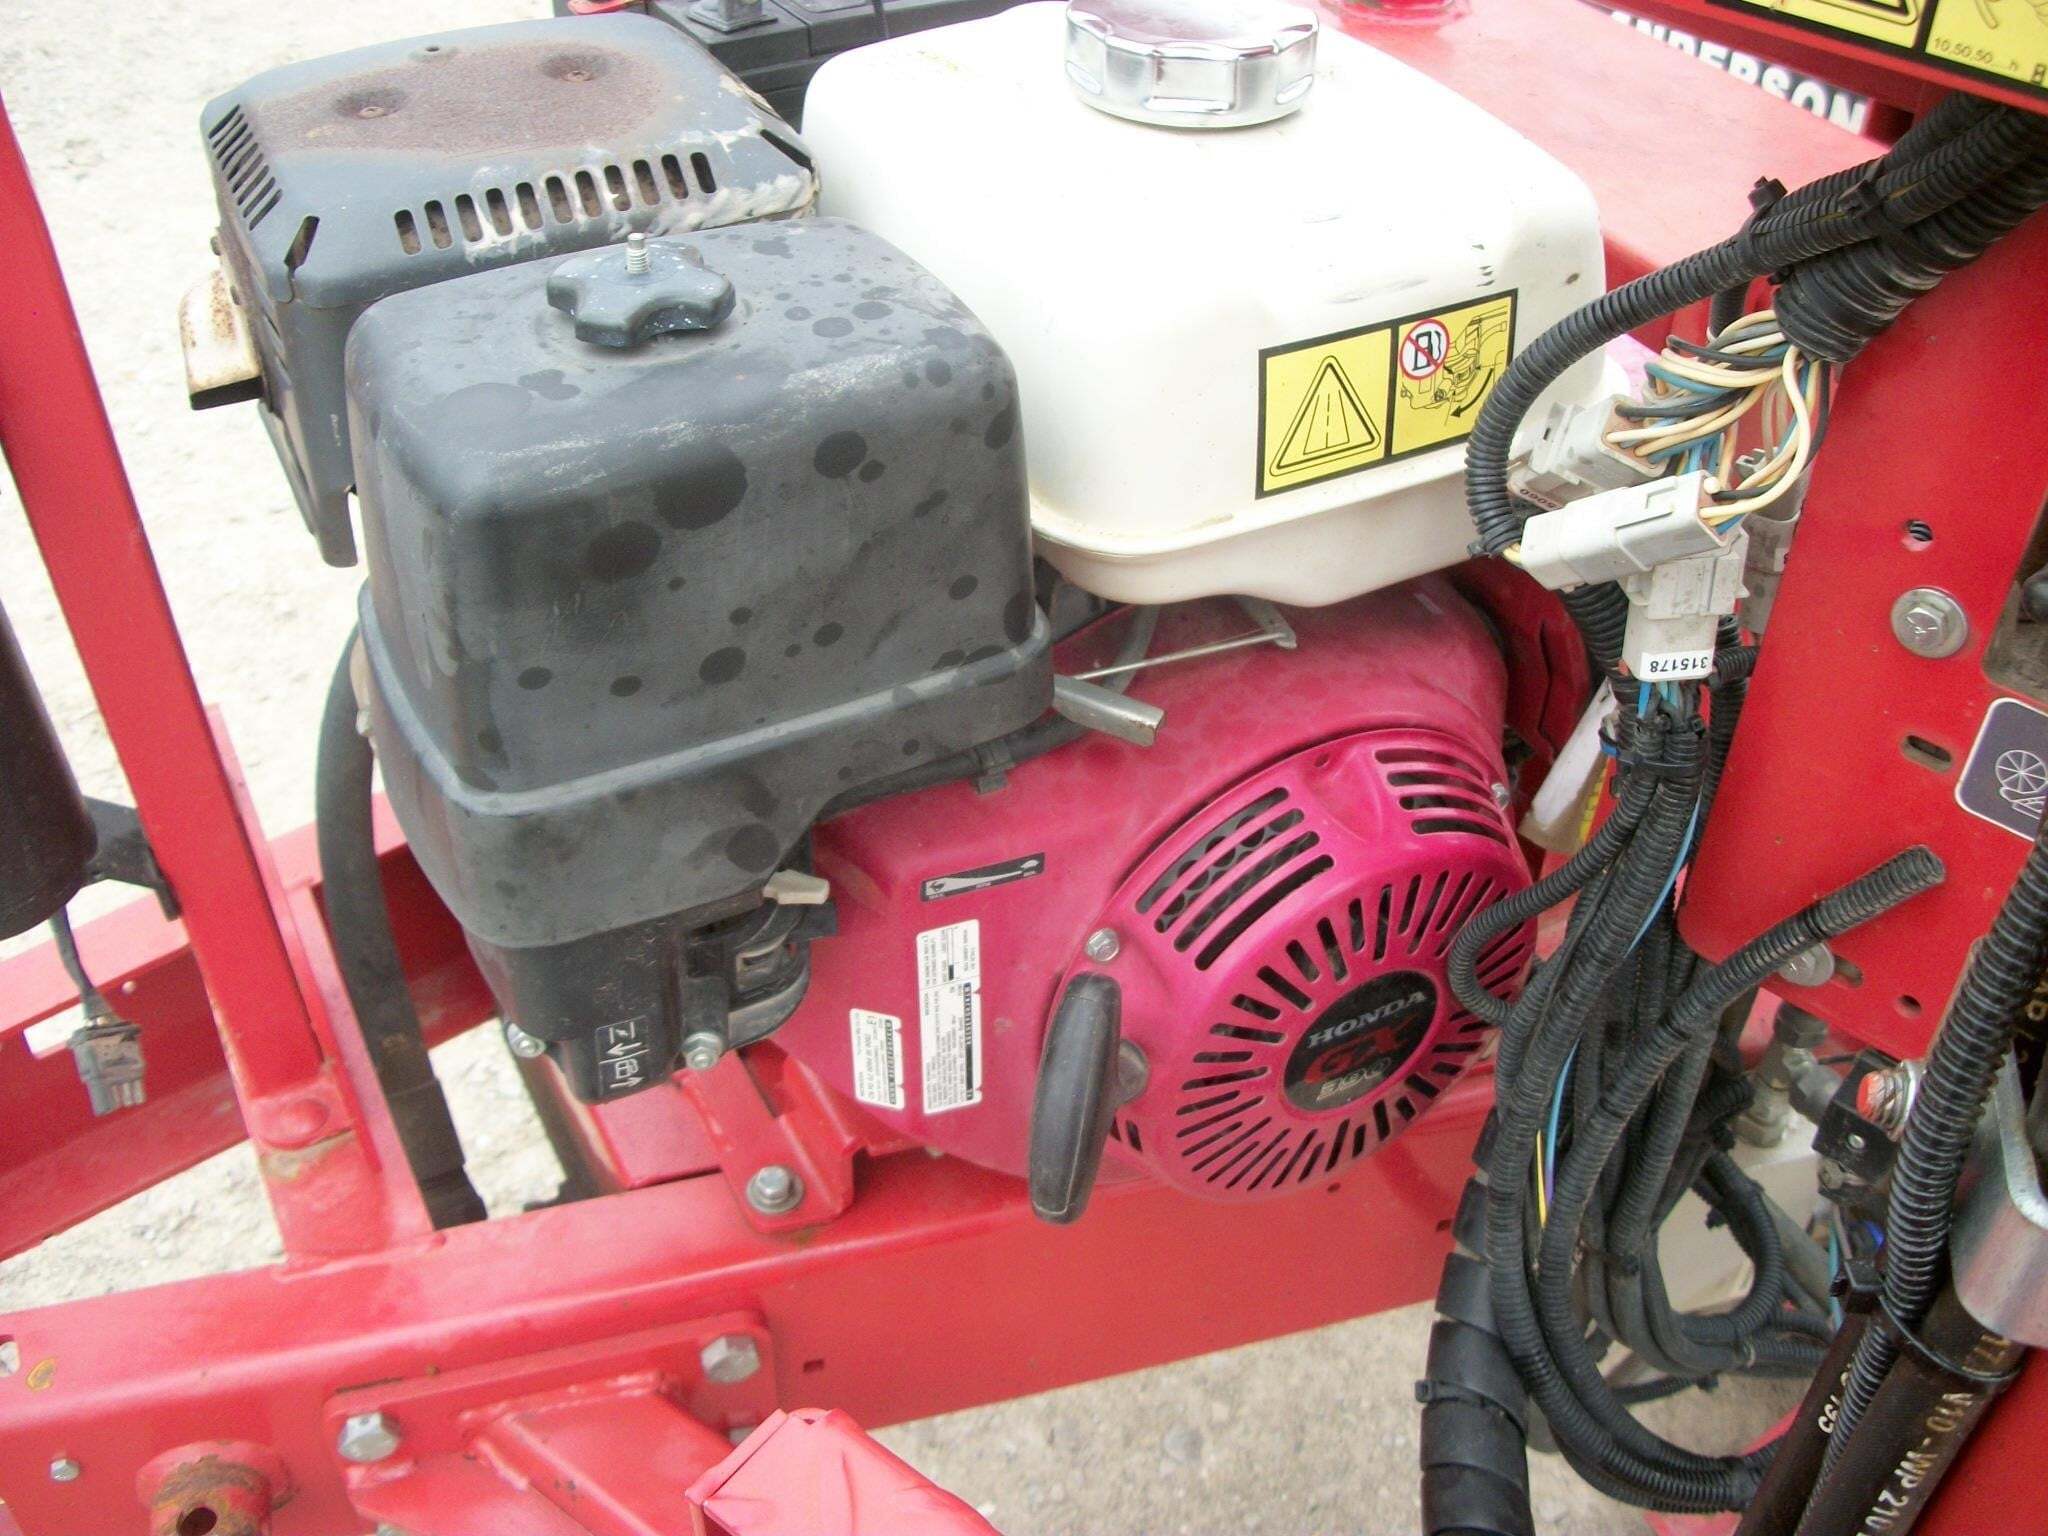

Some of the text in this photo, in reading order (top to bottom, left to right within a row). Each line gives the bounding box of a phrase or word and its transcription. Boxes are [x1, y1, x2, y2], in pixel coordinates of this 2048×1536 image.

[1649, 656, 1709, 673] 315178
[1307, 990, 1428, 1049] HONDA
[1864, 1488, 1910, 1531] 210
